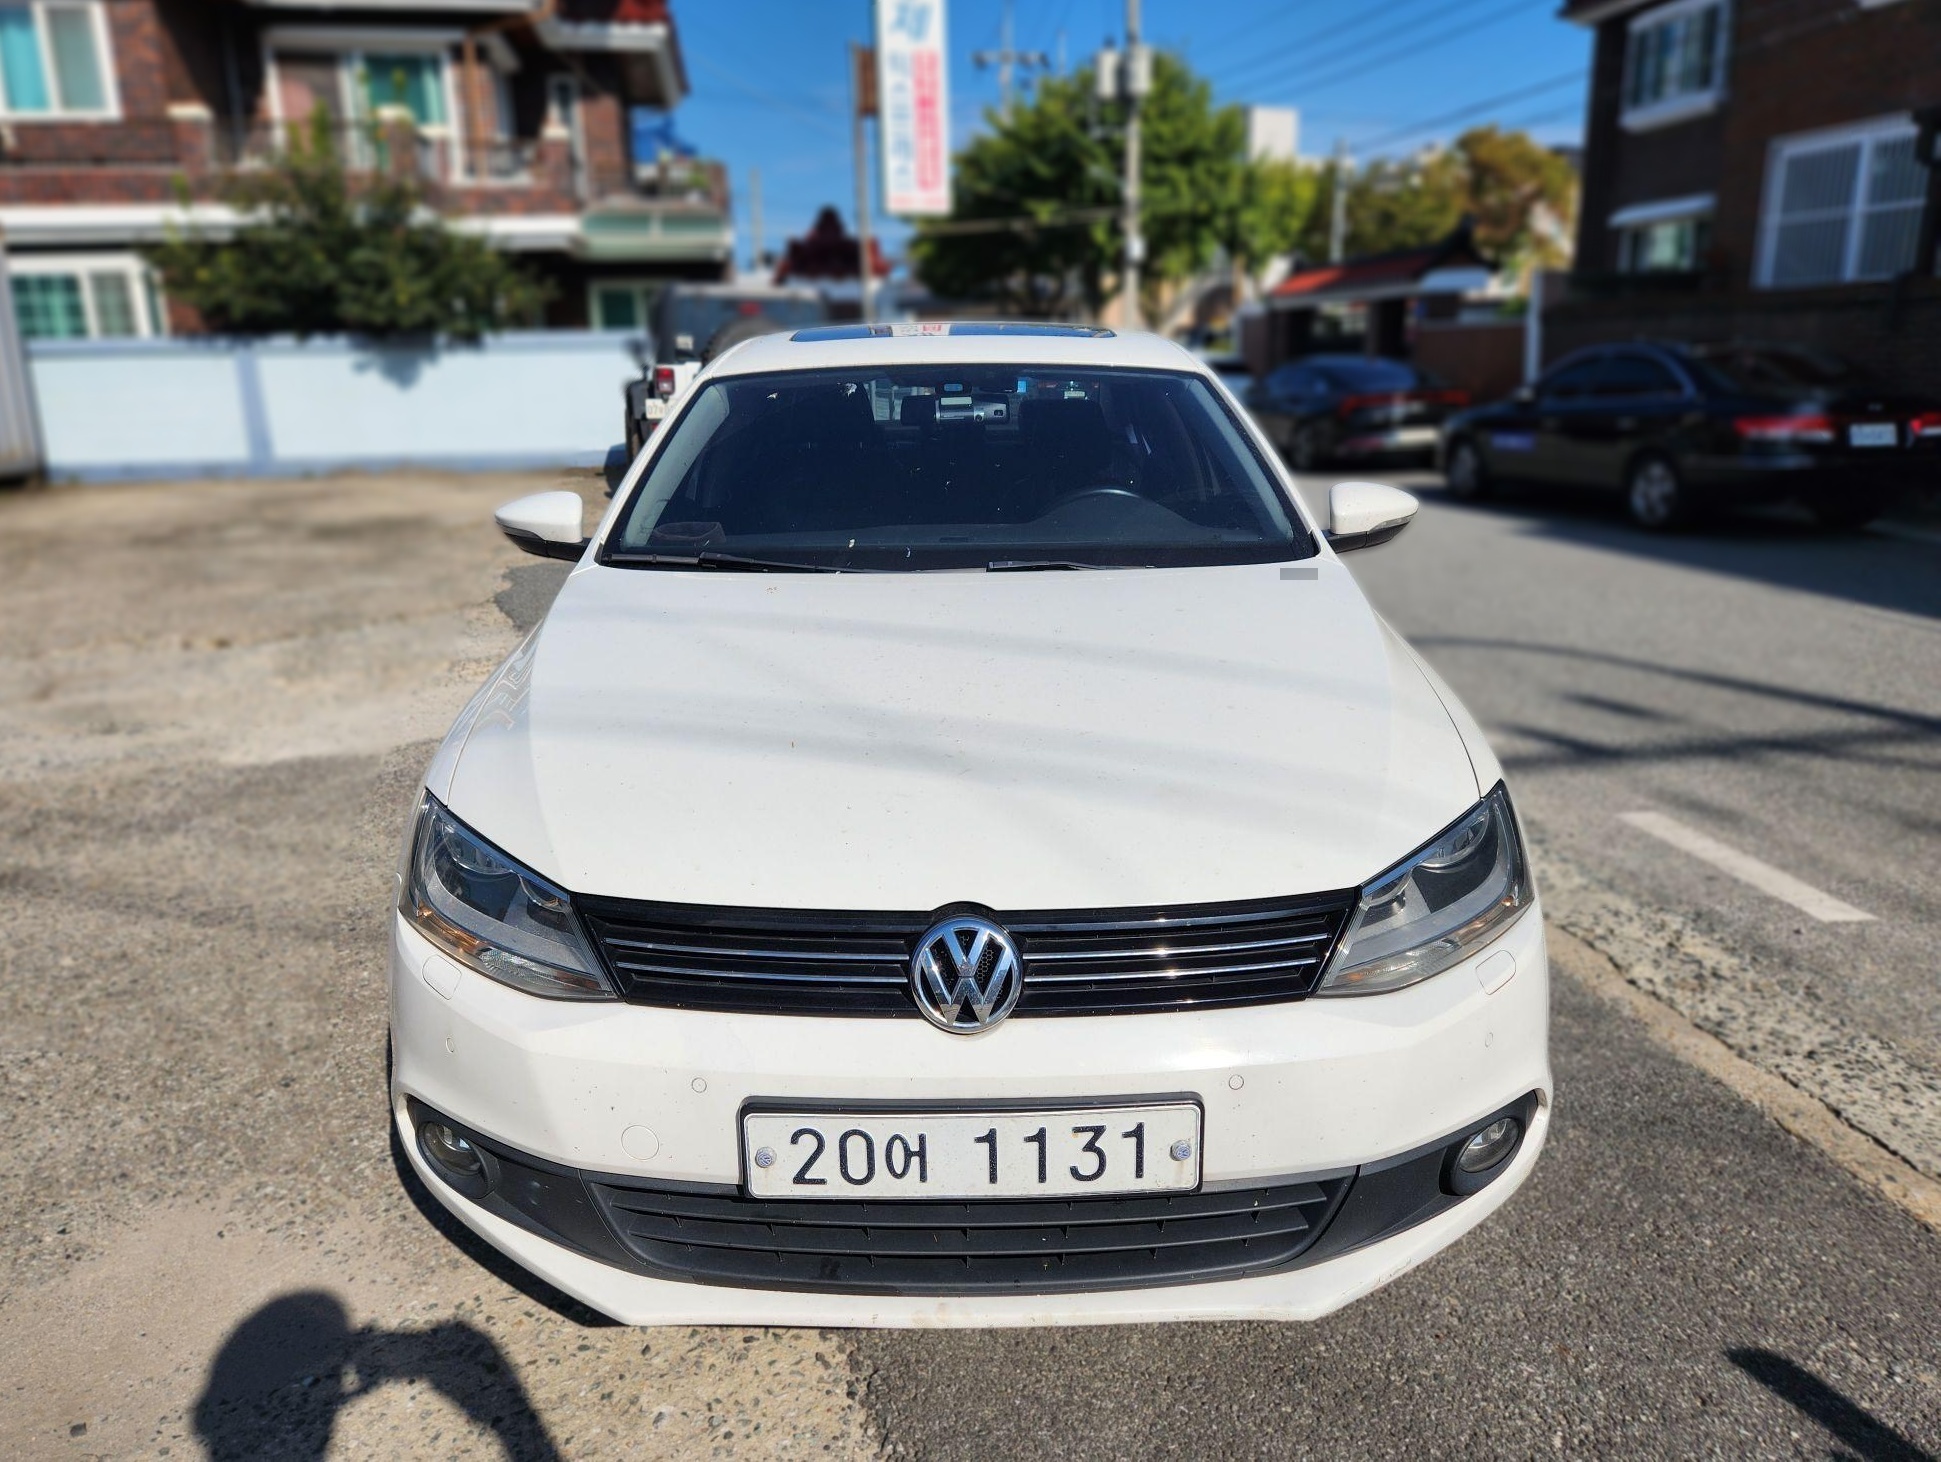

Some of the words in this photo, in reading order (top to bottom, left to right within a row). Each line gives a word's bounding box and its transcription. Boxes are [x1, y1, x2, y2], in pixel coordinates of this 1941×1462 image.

[911, 915, 1023, 1034] VW
[790, 1128, 927, 1185] 20어
[974, 1122, 1145, 1184] 1131
